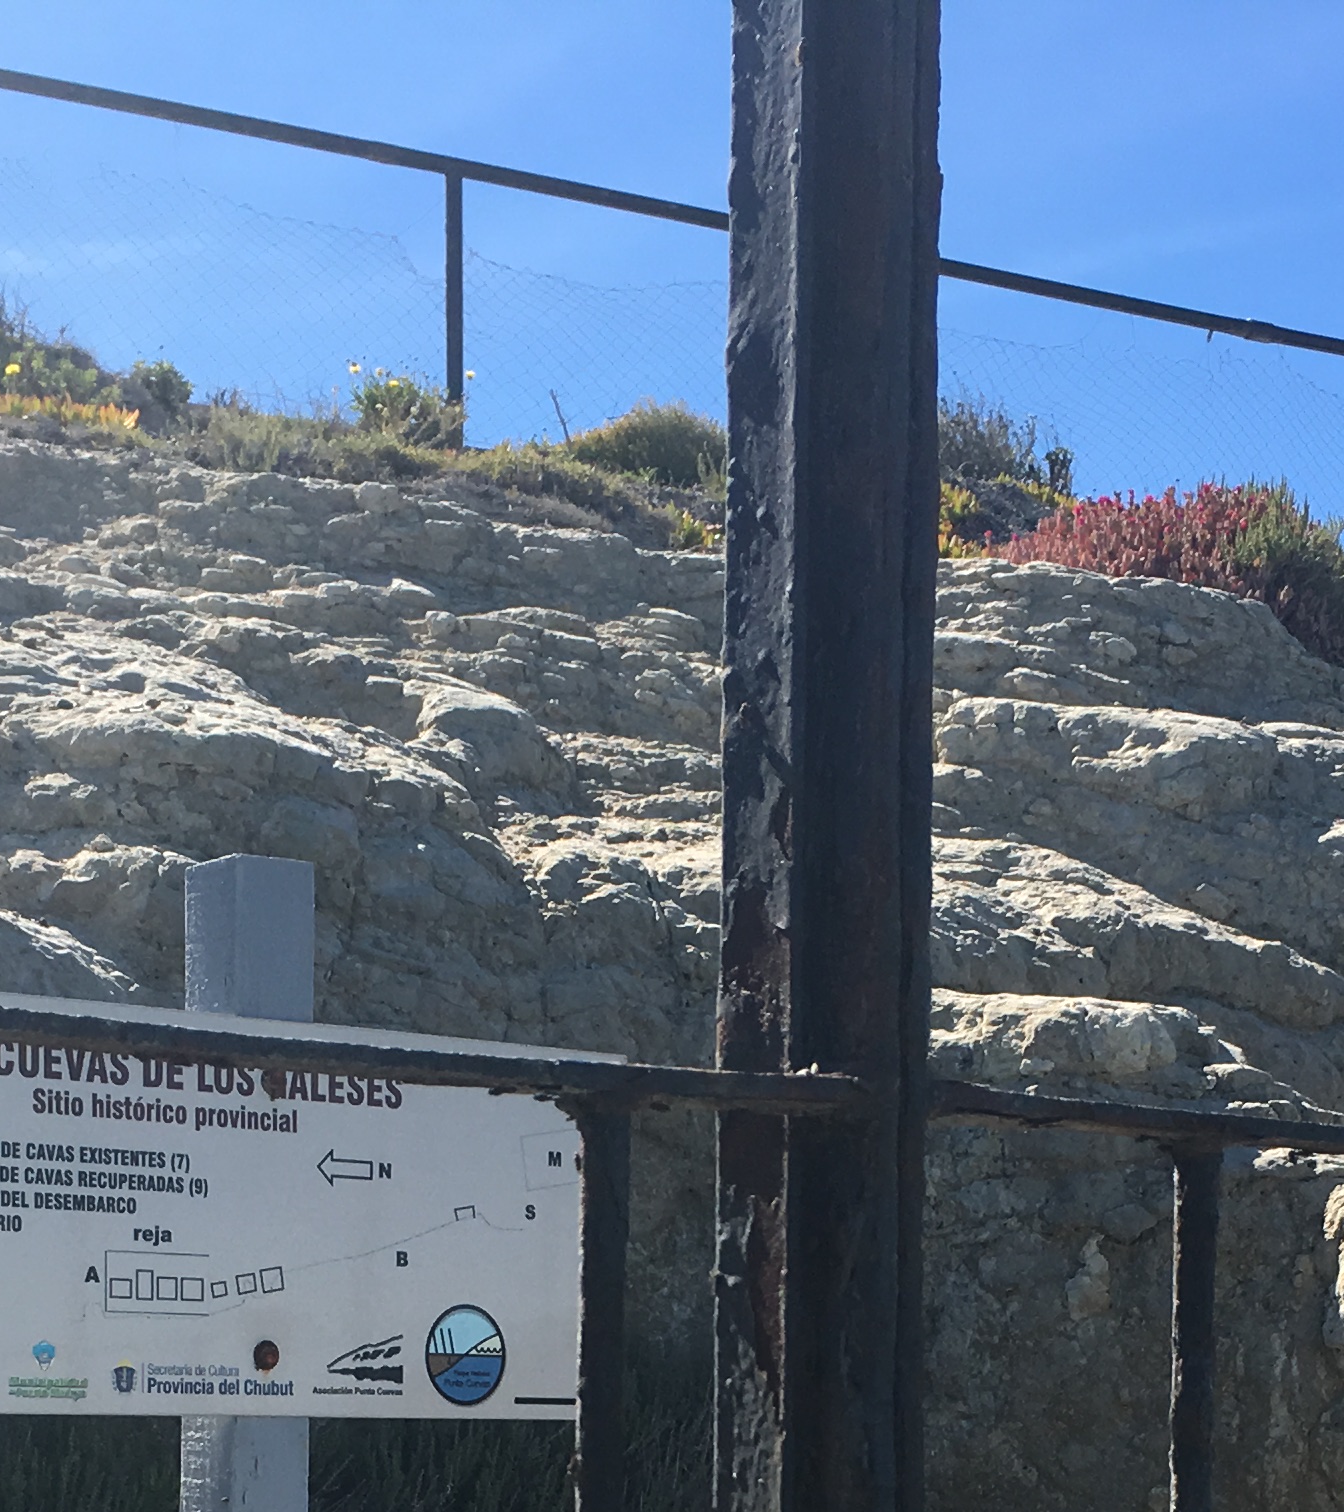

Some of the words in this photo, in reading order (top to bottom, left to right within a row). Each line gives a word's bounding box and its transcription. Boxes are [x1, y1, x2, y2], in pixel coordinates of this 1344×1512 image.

[143, 1059, 184, 1090] DE
[198, 1064, 254, 1096] LOS
[262, 1069, 403, 1109] ALESES
[32, 1087, 84, 1117] Sitio
[91, 1092, 188, 1125] histórico
[194, 1104, 298, 1134] provincial
[0, 1140, 21, 1159] DE
[25, 1142, 75, 1163] CAVAS
[79, 1146, 166, 1169] EXISTENTES
[170, 1152, 190, 1174] (7)
[548, 1150, 562, 1168] M
[378, 1162, 392, 1180] N
[0, 1165, 20, 1184] DE
[24, 1166, 74, 1187] CAVAS
[77, 1170, 185, 1194] RECUPERADAS
[189, 1177, 209, 1199] (9)
[0, 1190, 30, 1209] DEL
[33, 1191, 137, 1215] DESEMBARCO
[524, 1204, 536, 1221] S
[133, 1225, 173, 1247] reja
[396, 1250, 409, 1268] B
[84, 1265, 101, 1284] A
[195, 1364, 206, 1376] de
[208, 1364, 239, 1377] Cultura
[147, 1377, 215, 1395] Provincia
[219, 1379, 240, 1395] del
[244, 1379, 294, 1396] Chubut
